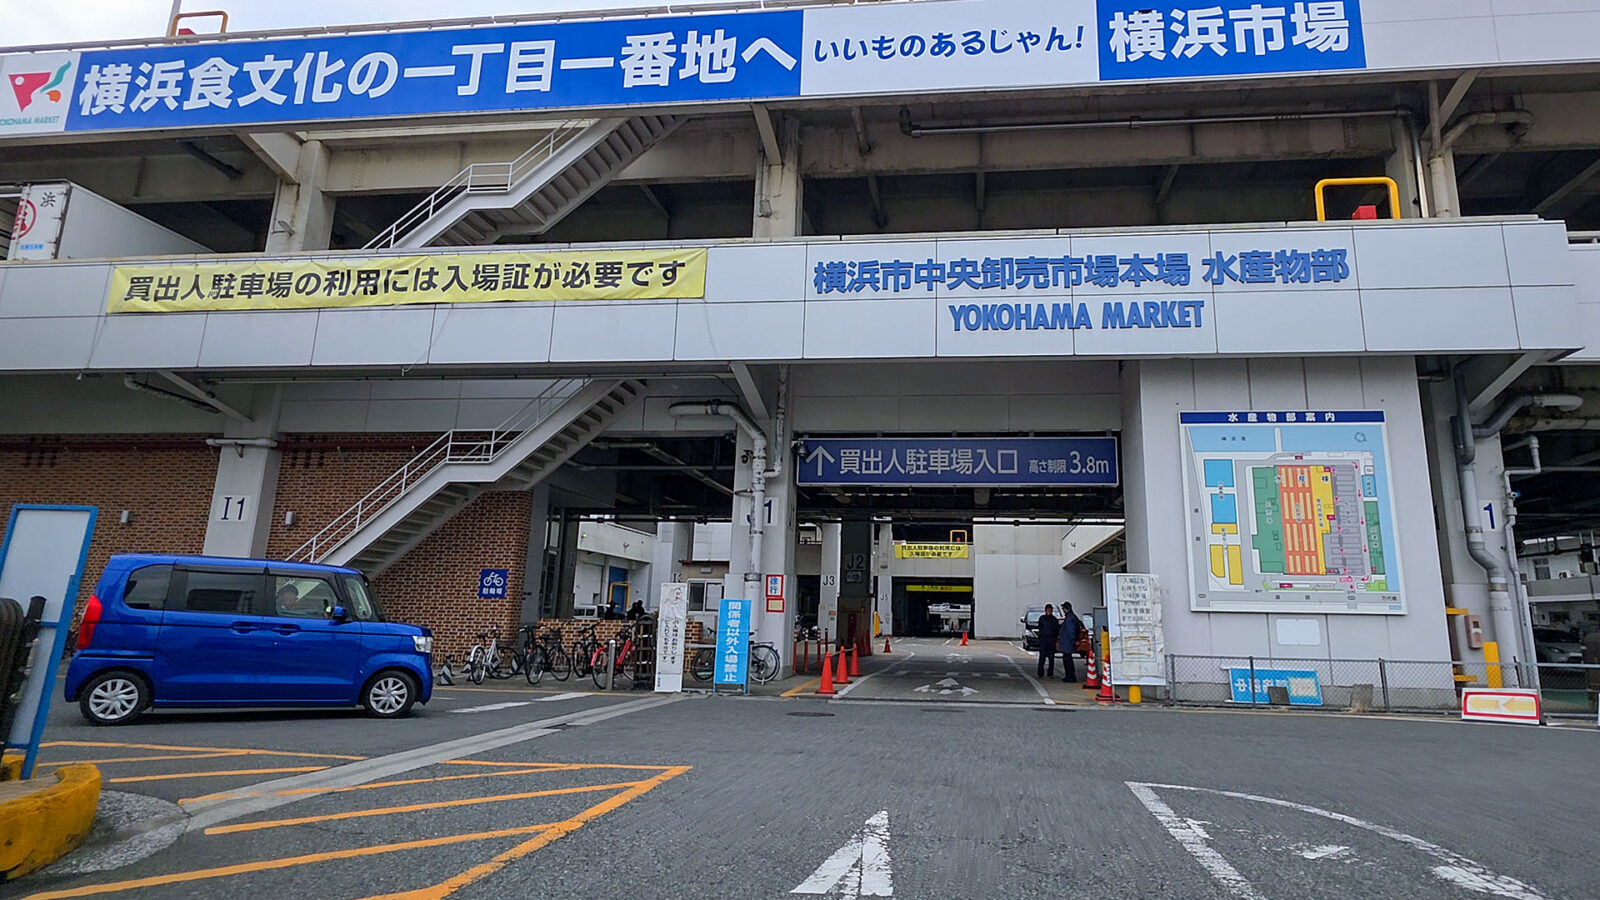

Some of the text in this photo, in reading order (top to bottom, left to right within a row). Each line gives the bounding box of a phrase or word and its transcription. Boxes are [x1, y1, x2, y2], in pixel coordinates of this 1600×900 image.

[1109, 1, 1350, 63] 横浜市場
[79, 29, 798, 117] 横浜食文化の一丁目一番地へ
[124, 259, 688, 303] 買出人駐車場の利用には入場証が必要です
[813, 248, 1350, 294] 横浜市中央卸売市場本場 水産物部
[949, 300, 1205, 332] YOKOHAMA MARKET
[839, 449, 1110, 475] 買出人駐車場入口 高さ制限 3.8m
[823, 574, 836, 586] J3
[847, 554, 864, 570] J2
[722, 601, 742, 682] 関係者以外入場禁止
